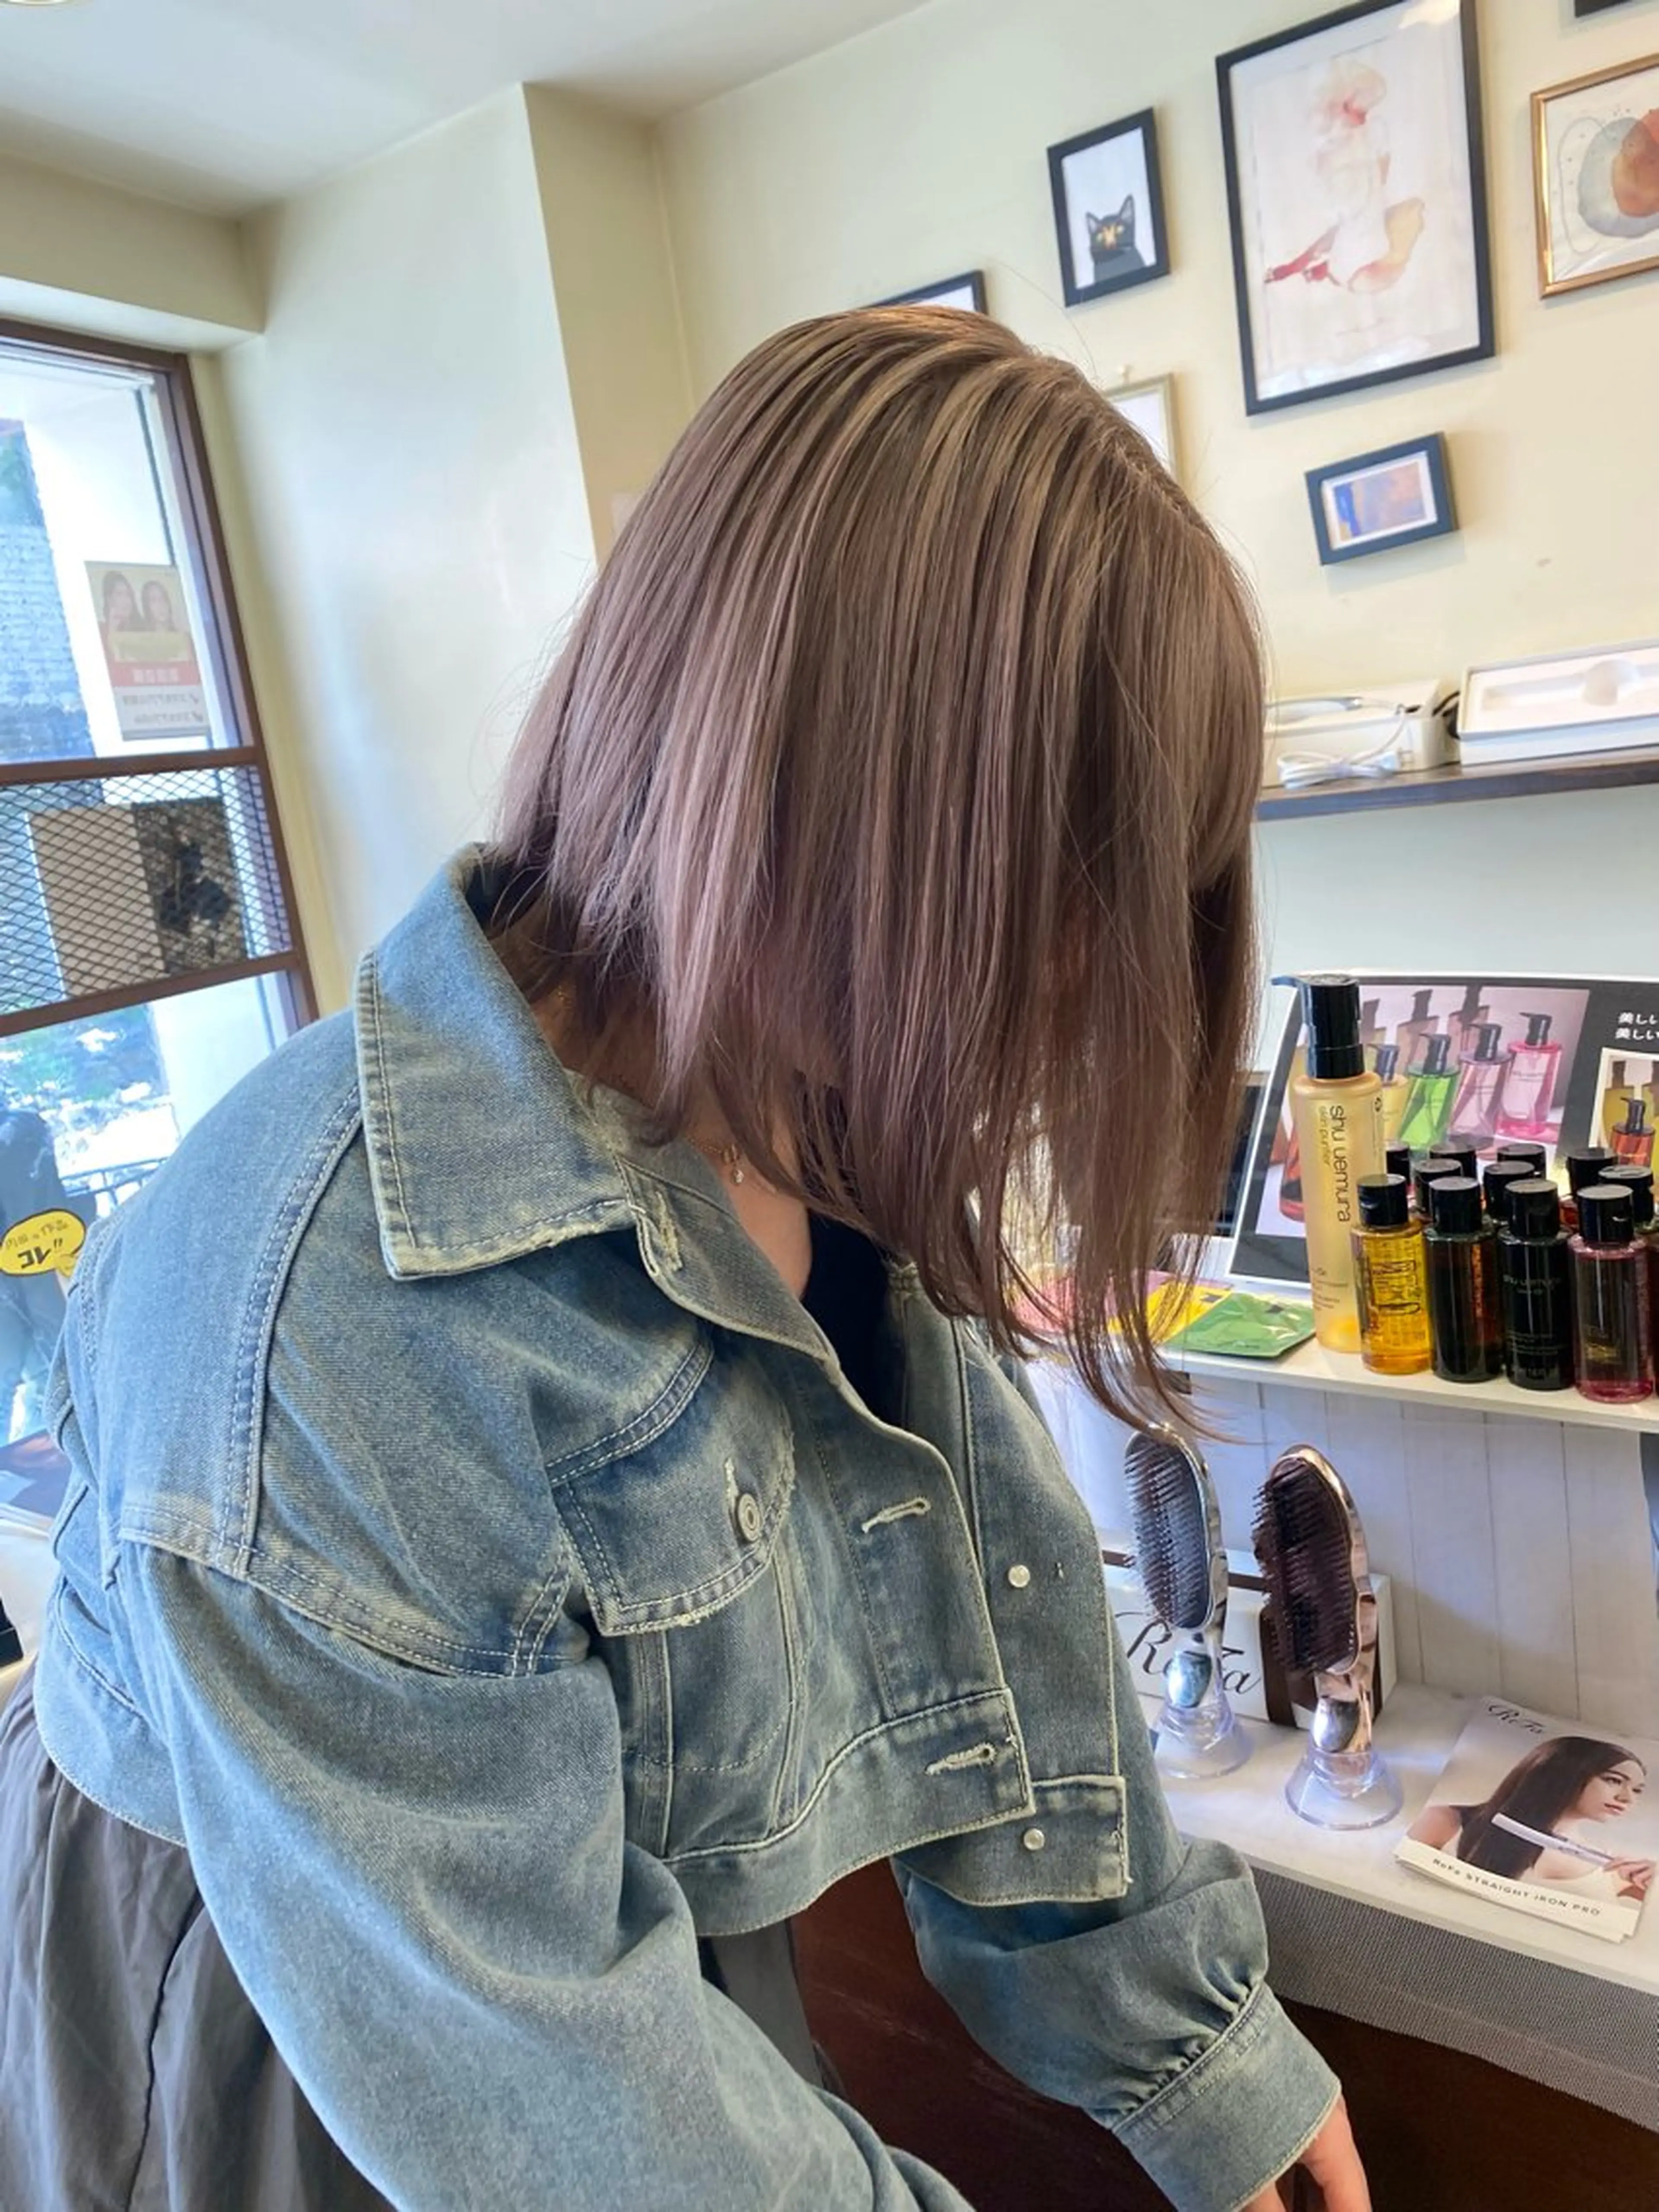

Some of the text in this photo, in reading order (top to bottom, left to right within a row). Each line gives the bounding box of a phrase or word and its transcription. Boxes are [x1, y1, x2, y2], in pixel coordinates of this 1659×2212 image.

[1329, 1105, 1351, 1222] shu uemura
[1466, 1872, 1529, 1897] STRAIGHT
